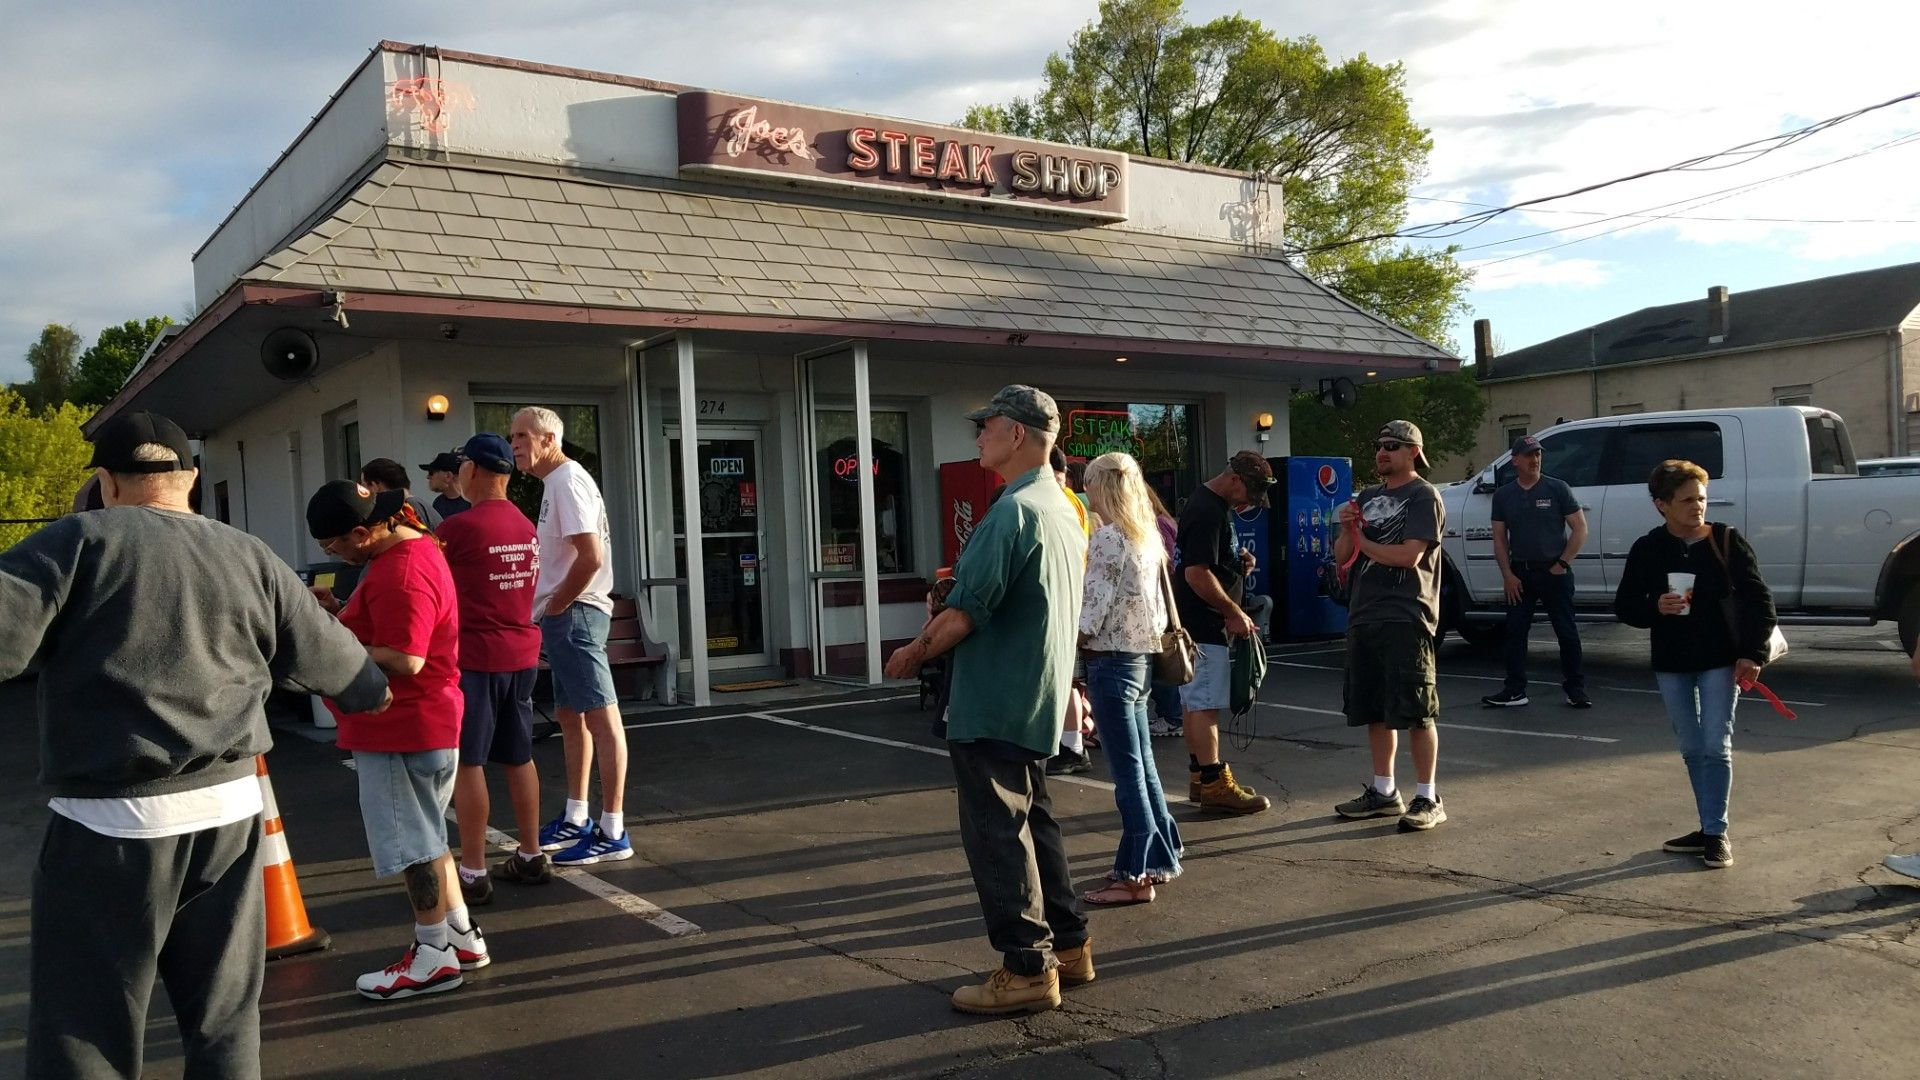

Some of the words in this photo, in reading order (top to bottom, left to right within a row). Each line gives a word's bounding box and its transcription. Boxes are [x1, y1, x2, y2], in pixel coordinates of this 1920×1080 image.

[847, 127, 997, 186] STEAK
[1011, 148, 1122, 199] SHOP
[700, 400, 726, 415] 274
[1073, 418, 1132, 437] STEAK
[712, 460, 742, 473] OPEN
[834, 458, 879, 475] OPN
[489, 544, 532, 554] BROADWAY
[500, 553, 525, 563] TEXACO
[823, 555, 853, 566] WANTED
[489, 572, 515, 581] Service
[515, 571, 533, 579] Center
